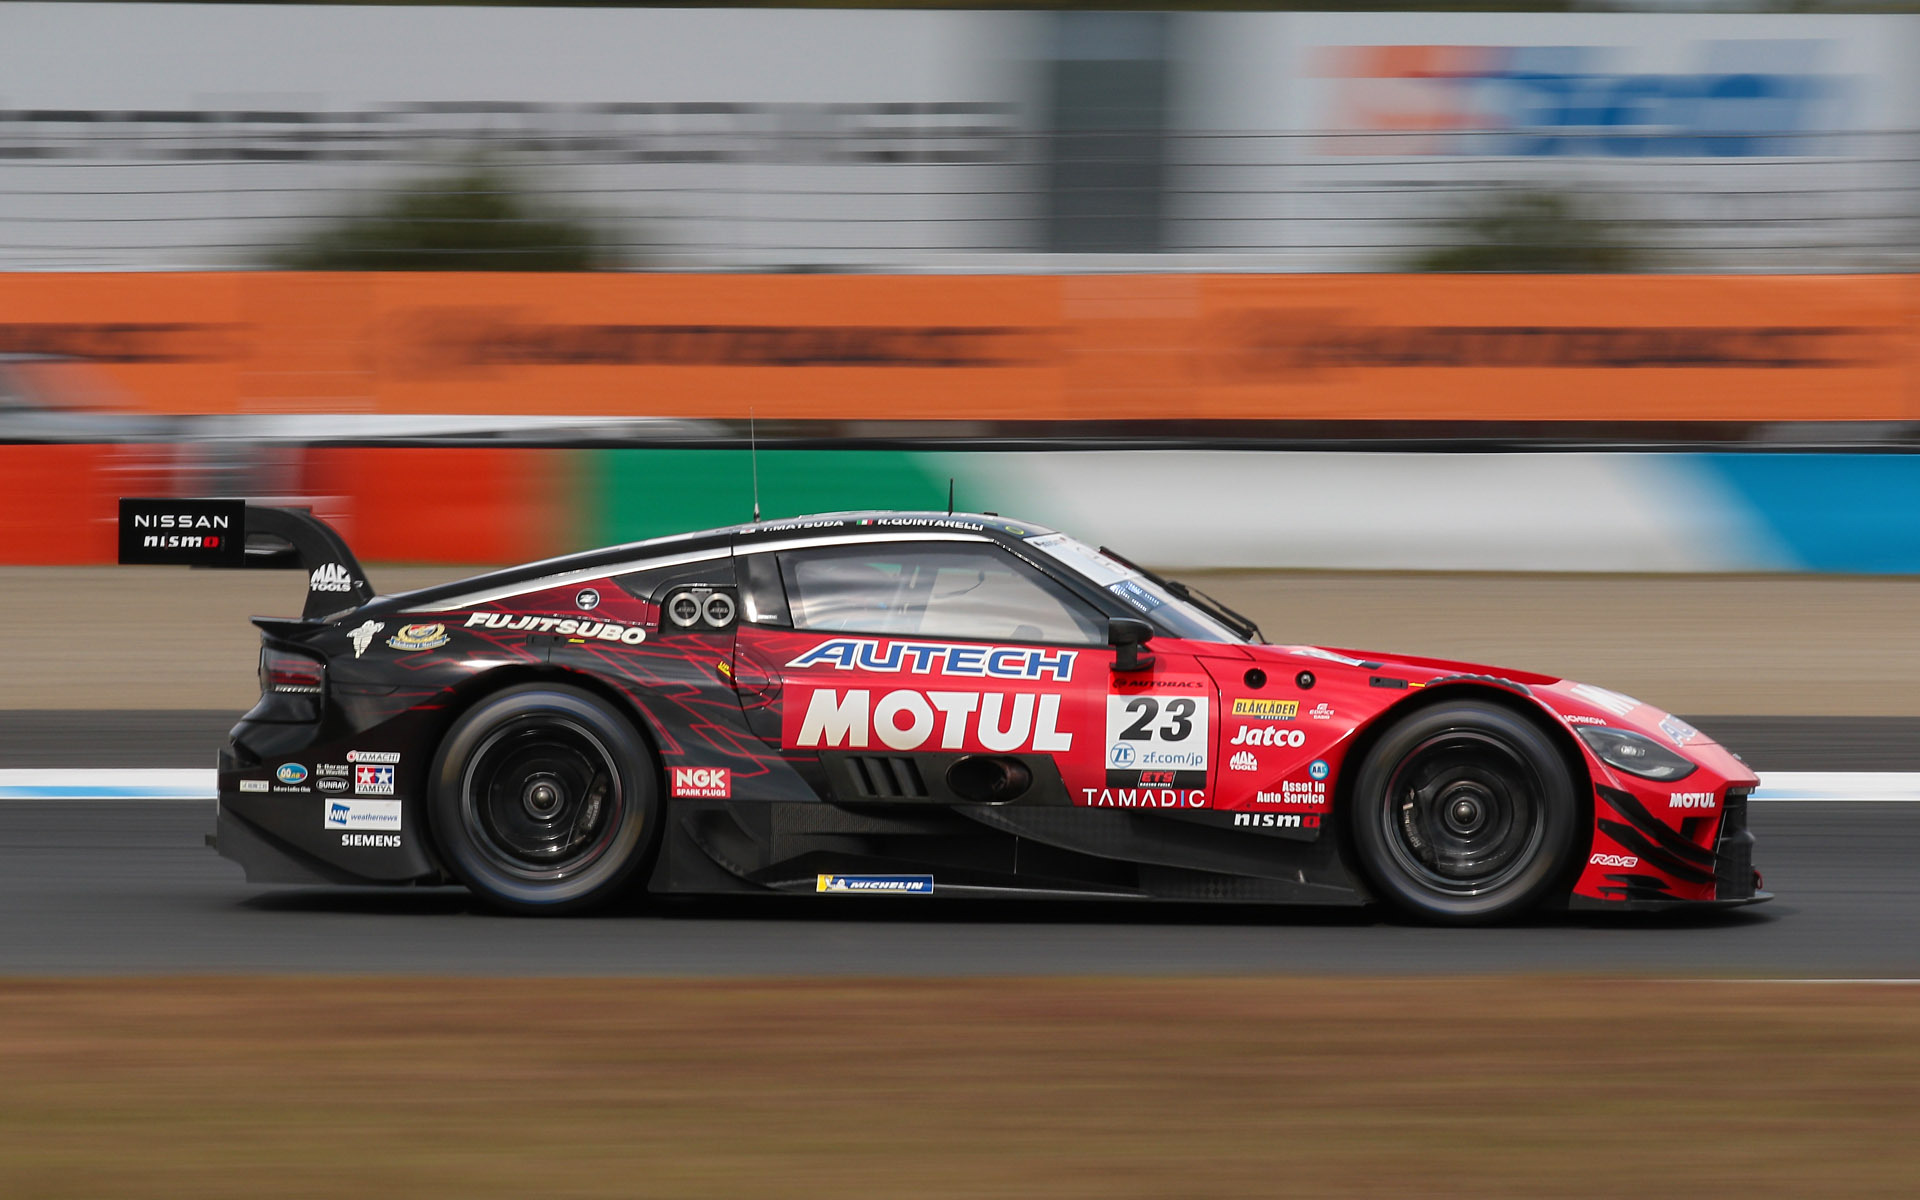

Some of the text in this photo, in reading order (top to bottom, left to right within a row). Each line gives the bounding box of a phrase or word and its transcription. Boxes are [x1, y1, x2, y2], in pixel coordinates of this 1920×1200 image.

[134, 514, 229, 529] NISSAN
[143, 534, 220, 548] nismo
[311, 562, 351, 583] MAC
[310, 582, 351, 593] TOOLS
[464, 612, 647, 645] FUJITSUBO
[785, 638, 1079, 682] AUTECH
[1129, 680, 1204, 688] AUTOBACS
[1235, 700, 1296, 716] BLÅKLÄDER
[796, 689, 1073, 751] MOTUL
[1118, 697, 1197, 742] 23
[1230, 725, 1306, 748] Jatco
[357, 752, 399, 761] TAMACHI
[1142, 751, 1204, 766] zf.com/jp
[1230, 751, 1257, 764] MAC
[1230, 763, 1258, 771] TOOLS
[318, 780, 347, 790] SUNRAY
[676, 768, 726, 789] NGK
[357, 784, 393, 793] TAMIYA
[676, 788, 726, 798] SPARK PLUGS
[1282, 780, 1312, 793] Asset
[1082, 788, 1205, 808] TAMADIC
[1257, 791, 1325, 804] Auto Service
[1669, 793, 1716, 808] MOTUL
[351, 813, 398, 822] weathernews
[1234, 813, 1320, 829] nismo
[341, 834, 401, 847] SIEMENS
[1590, 853, 1638, 868] RAYS
[849, 881, 924, 890] MICHELIN
